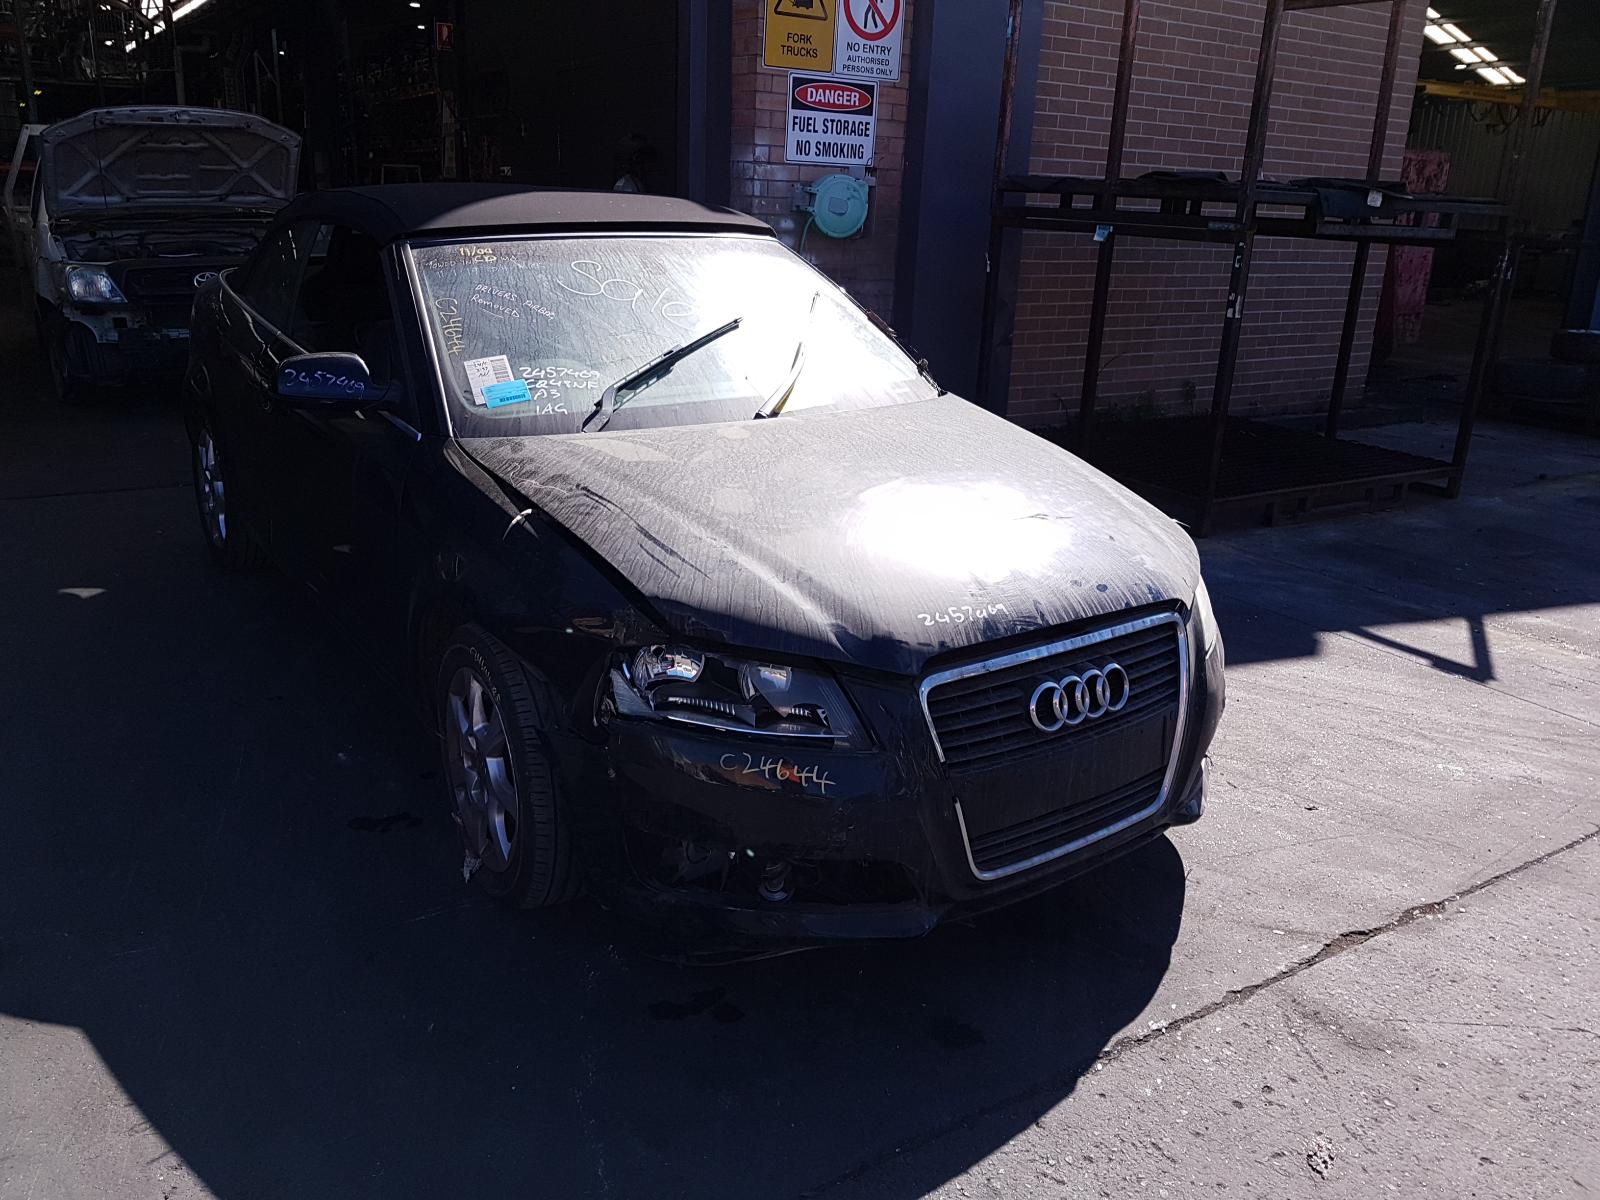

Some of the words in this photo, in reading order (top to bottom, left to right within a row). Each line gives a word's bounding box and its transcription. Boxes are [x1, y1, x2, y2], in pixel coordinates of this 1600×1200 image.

[786, 32, 813, 45] FORK
[780, 44, 818, 58] TRUCKS
[846, 41, 860, 52] NO
[863, 43, 892, 56] ENTRY
[847, 54, 890, 67] AUTHORISED
[842, 64, 874, 75] PERSONS
[875, 66, 893, 77] ONLY
[807, 87, 860, 107] DANGER
[792, 115, 818, 134] FUEL
[822, 118, 870, 138] STORAGE
[795, 139, 811, 157] NO
[814, 141, 864, 160] SMOKING
[475, 284, 518, 302] DRIVERS
[435, 297, 466, 357] C24644
[720, 752, 836, 794] C24644
